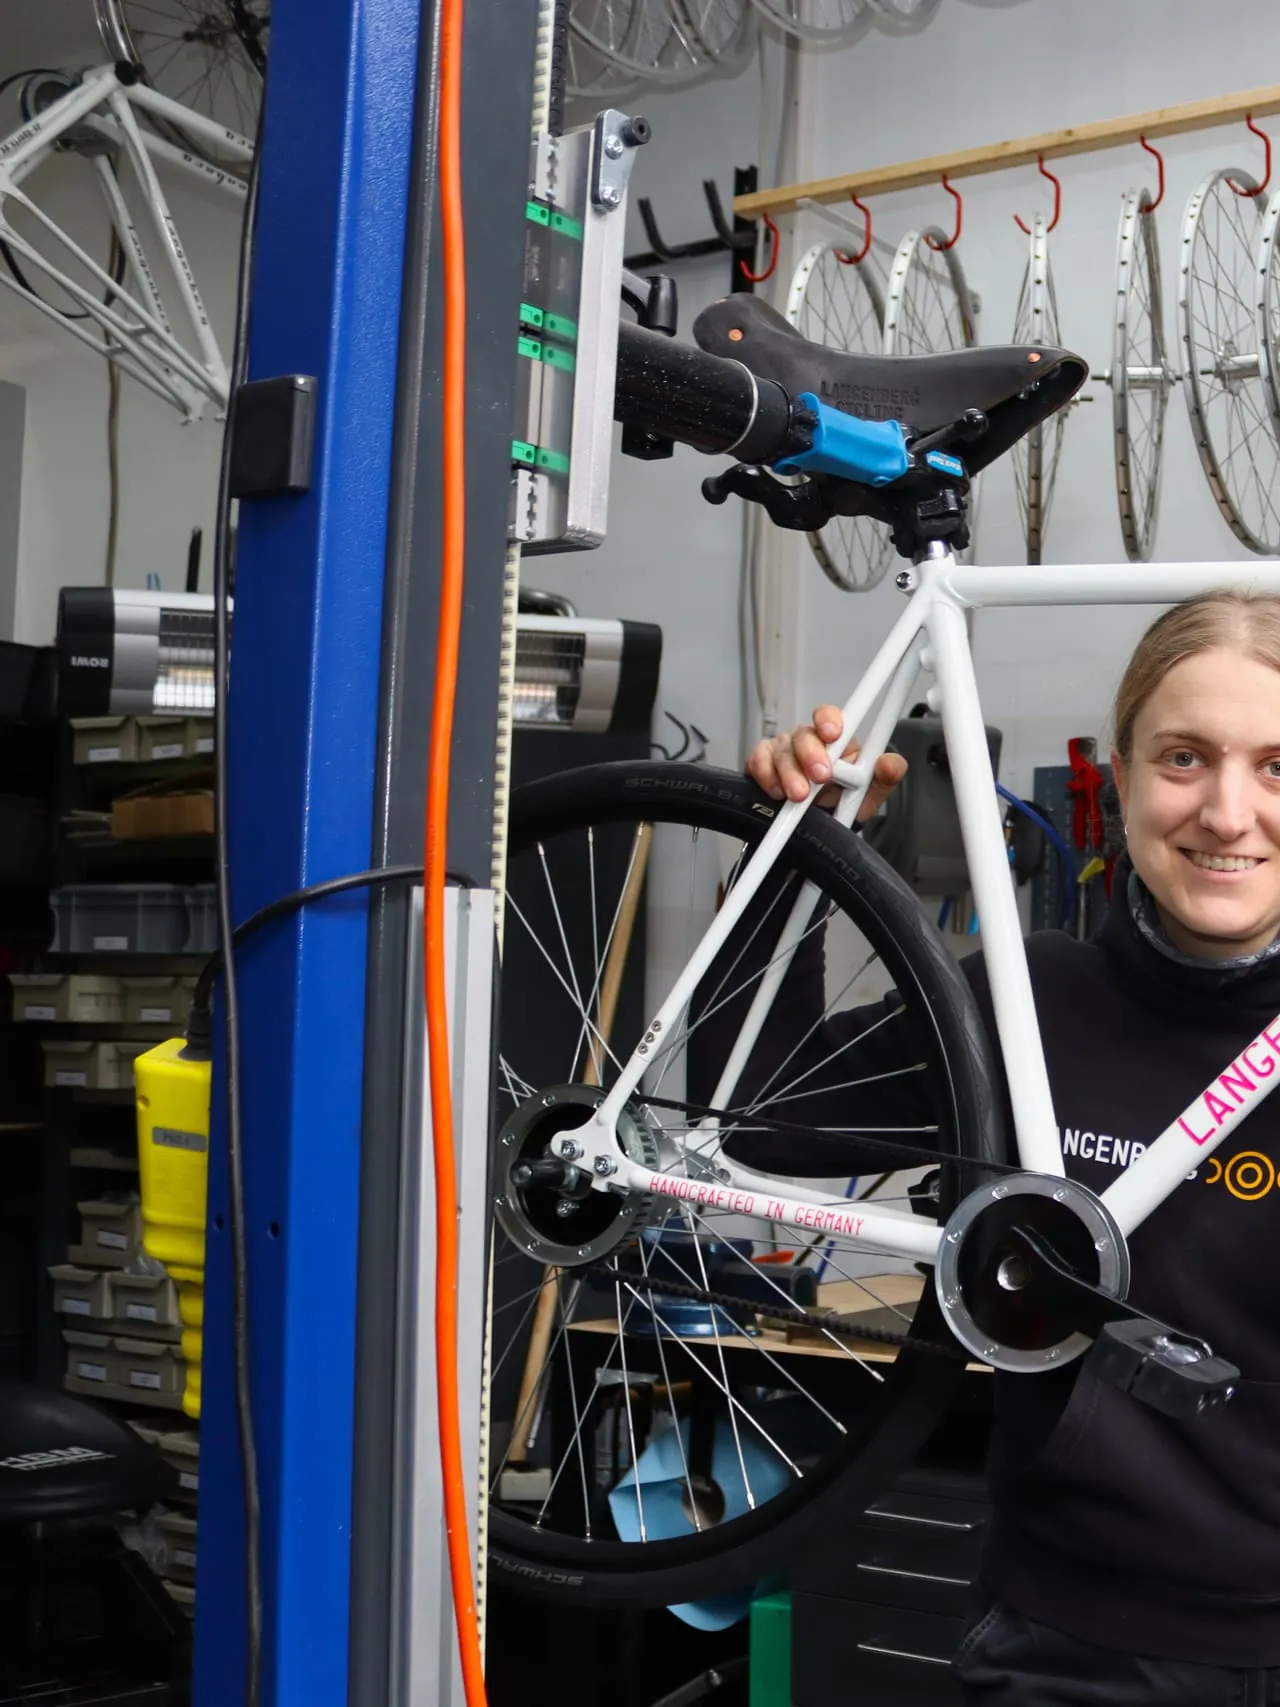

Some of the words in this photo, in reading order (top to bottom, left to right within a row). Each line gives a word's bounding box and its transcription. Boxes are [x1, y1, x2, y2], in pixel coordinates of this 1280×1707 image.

[649, 1175, 755, 1214] HANDCRAFTED
[763, 1200, 786, 1221] IN
[795, 1207, 865, 1236] GERMANY
[488, 1553, 584, 1586] SCHWAL
